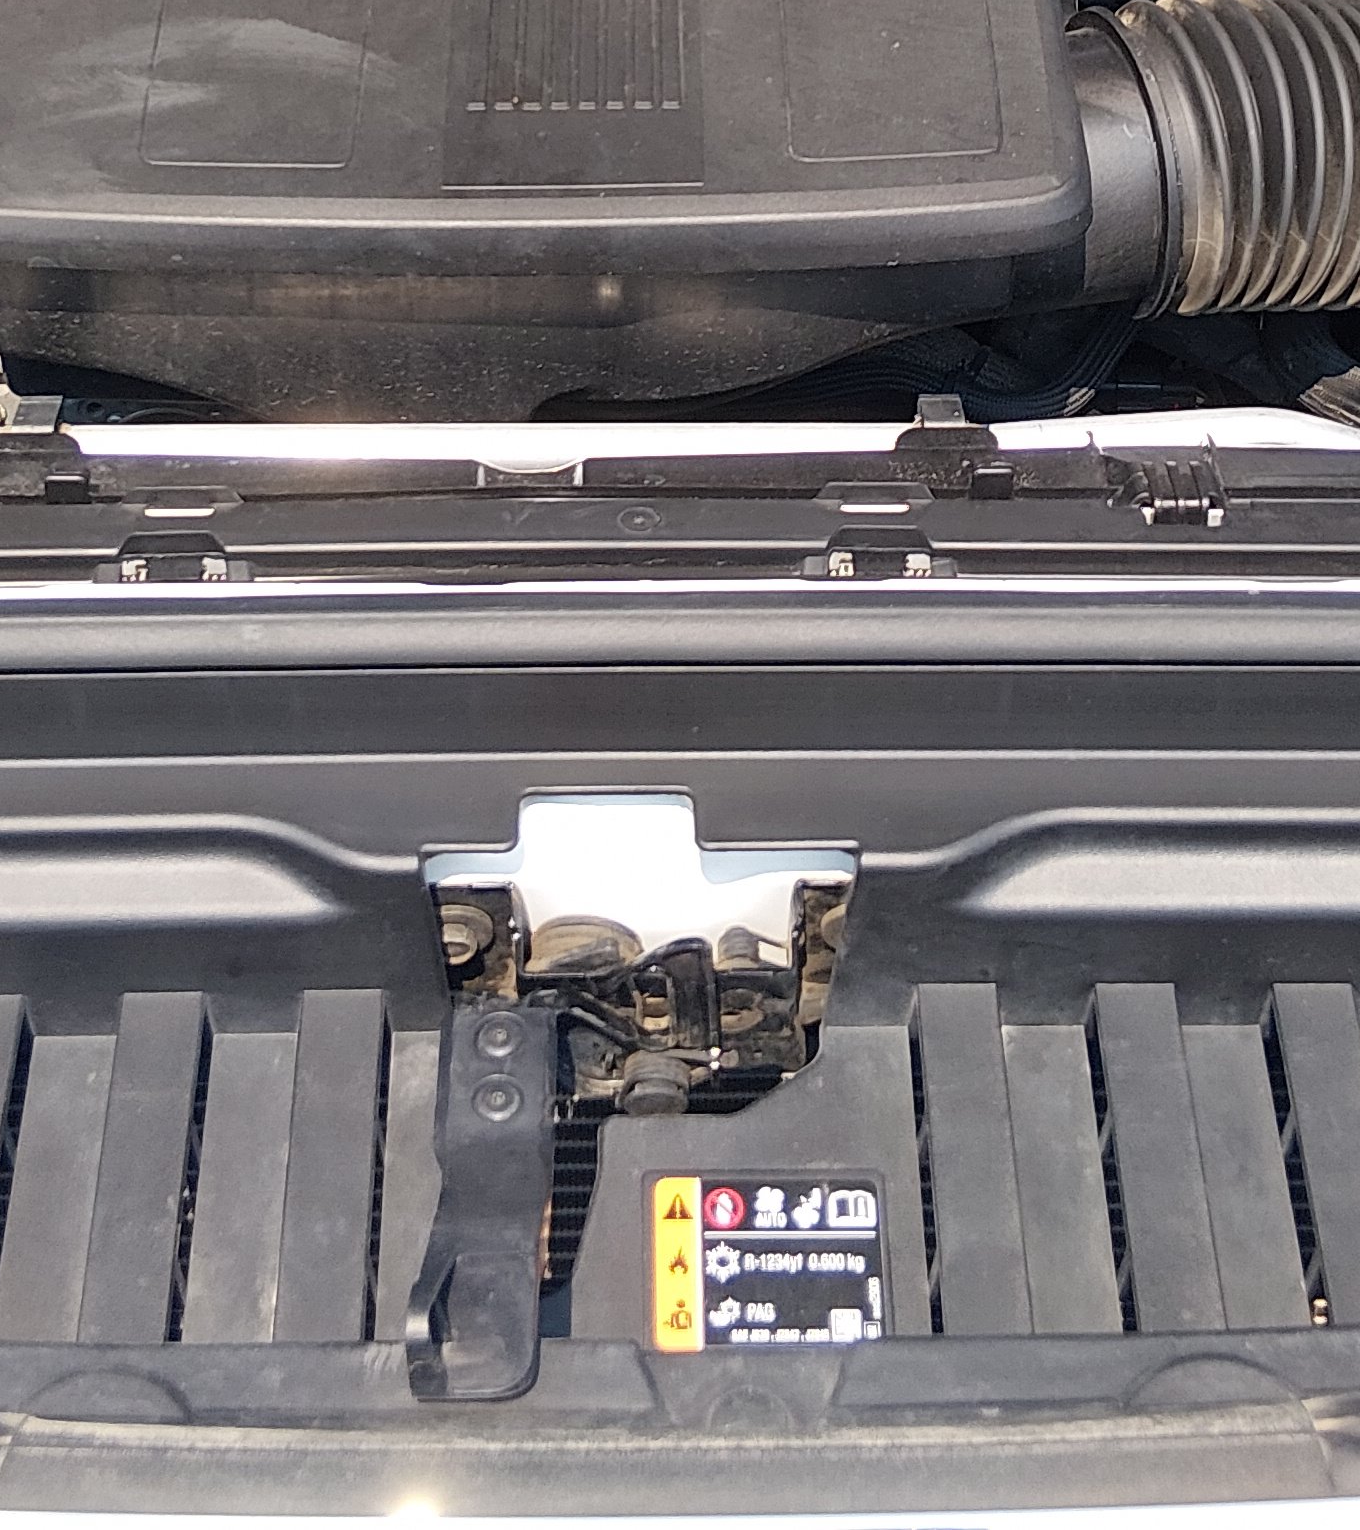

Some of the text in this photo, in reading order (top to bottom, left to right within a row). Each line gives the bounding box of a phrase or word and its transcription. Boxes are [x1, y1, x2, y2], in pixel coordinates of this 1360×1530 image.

[755, 1211, 787, 1228] AUTO
[744, 1253, 865, 1274] R-1234yf 0.600 kg
[746, 1302, 776, 1322] PAG
